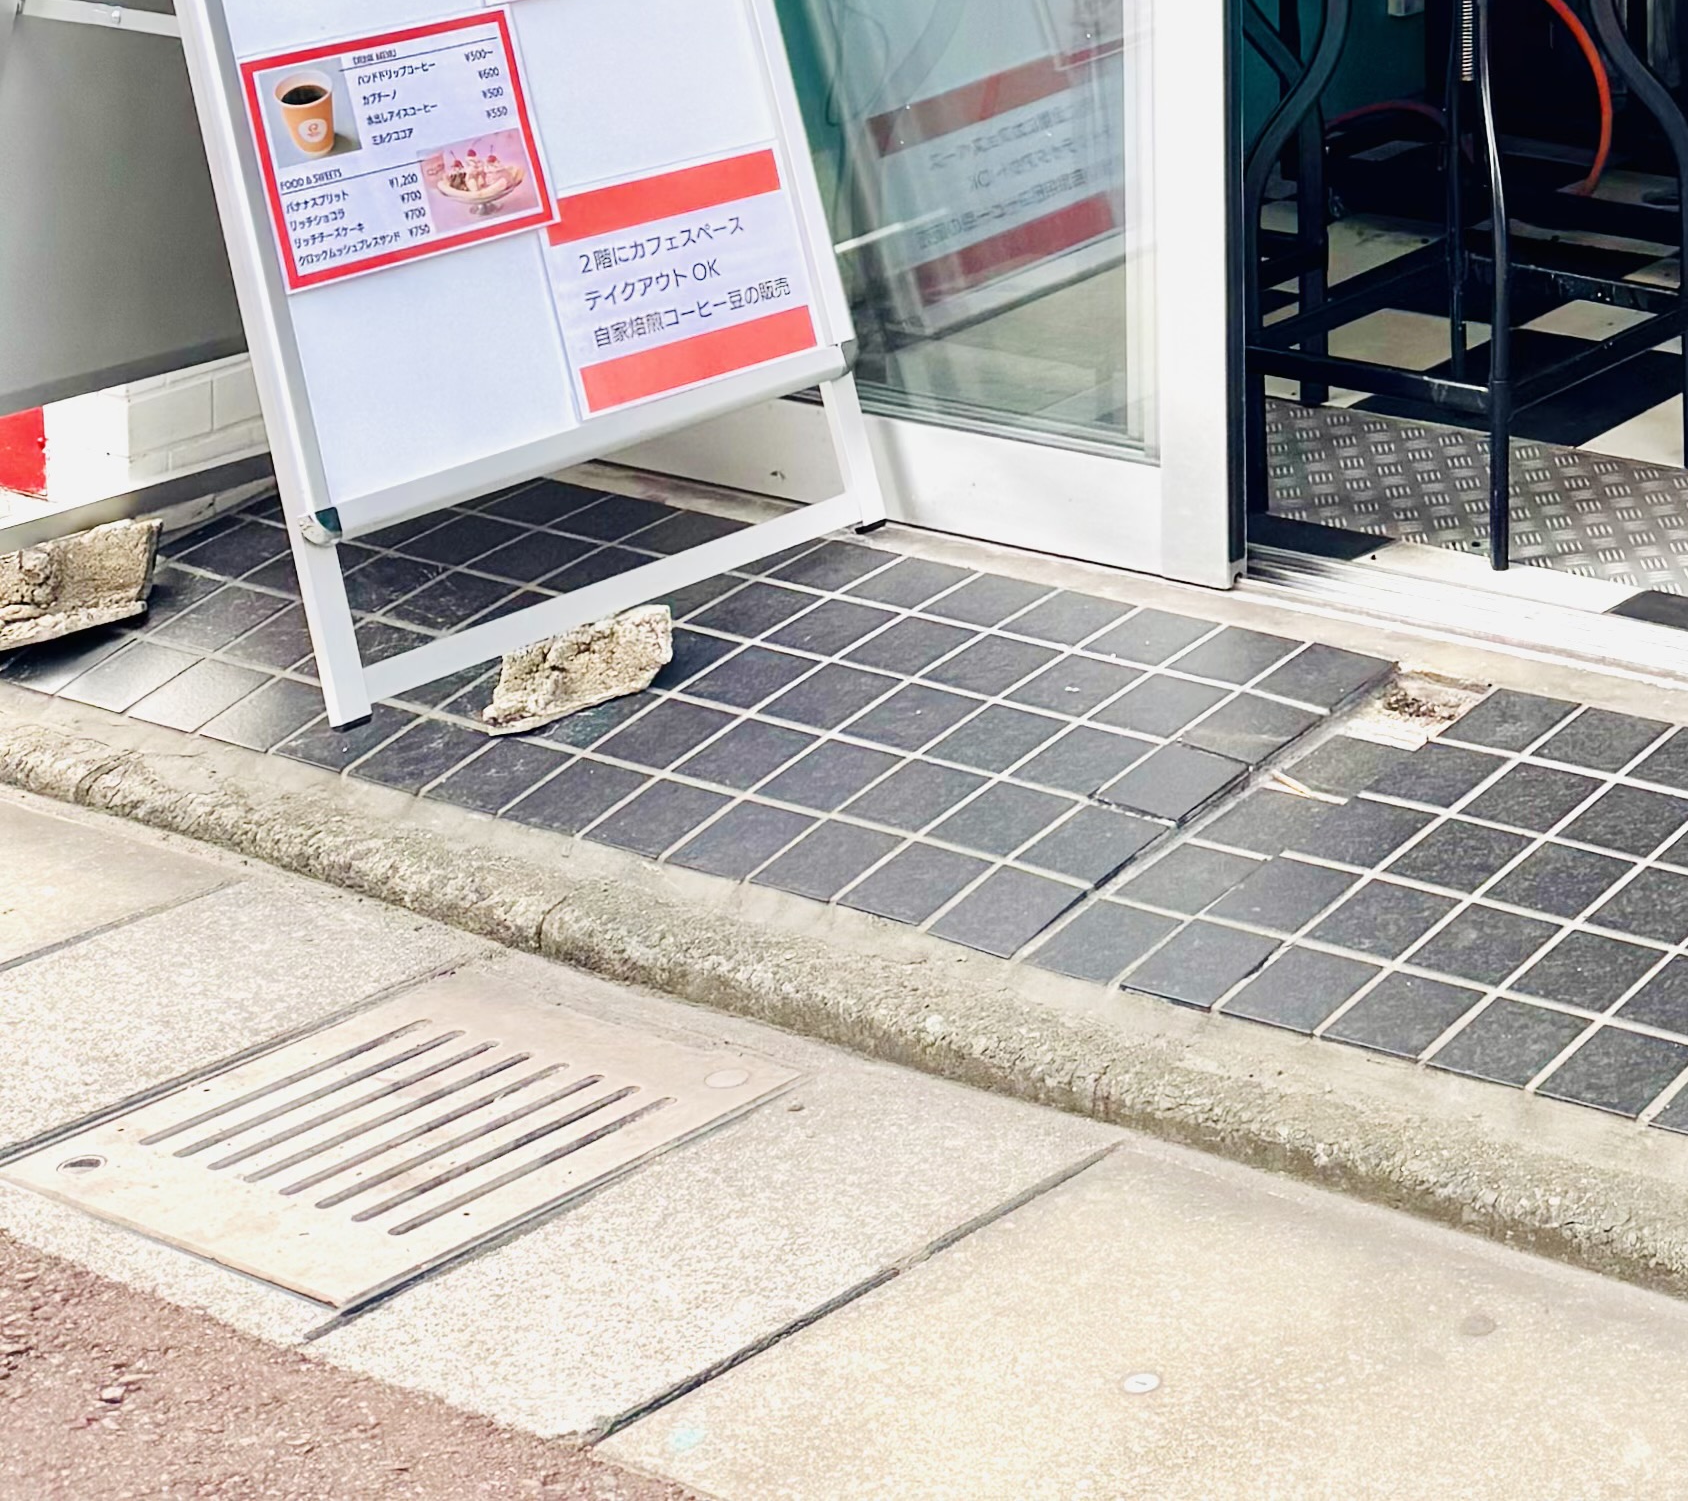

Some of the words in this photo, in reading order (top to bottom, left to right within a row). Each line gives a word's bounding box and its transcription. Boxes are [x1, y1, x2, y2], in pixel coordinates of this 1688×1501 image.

[358, 62, 436, 85] ハンドドリップコーヒー
[362, 89, 397, 106] カプチーノ
[366, 103, 438, 126] 水出しアイスコーヒー
[371, 128, 414, 146] ミルクココア
[280, 178, 304, 191] FOOD
[286, 190, 349, 214] バナナスプリット
[389, 173, 418, 189] ¥1,200
[289, 208, 345, 232] リッチショコラ
[294, 222, 365, 249] リッチチーズケーキ
[579, 216, 744, 274] 2階にカフェスペース
[584, 268, 688, 311] テイクアウト
[692, 258, 721, 281] OK
[594, 277, 791, 348] 自家焙煎コーヒー豆の販売
